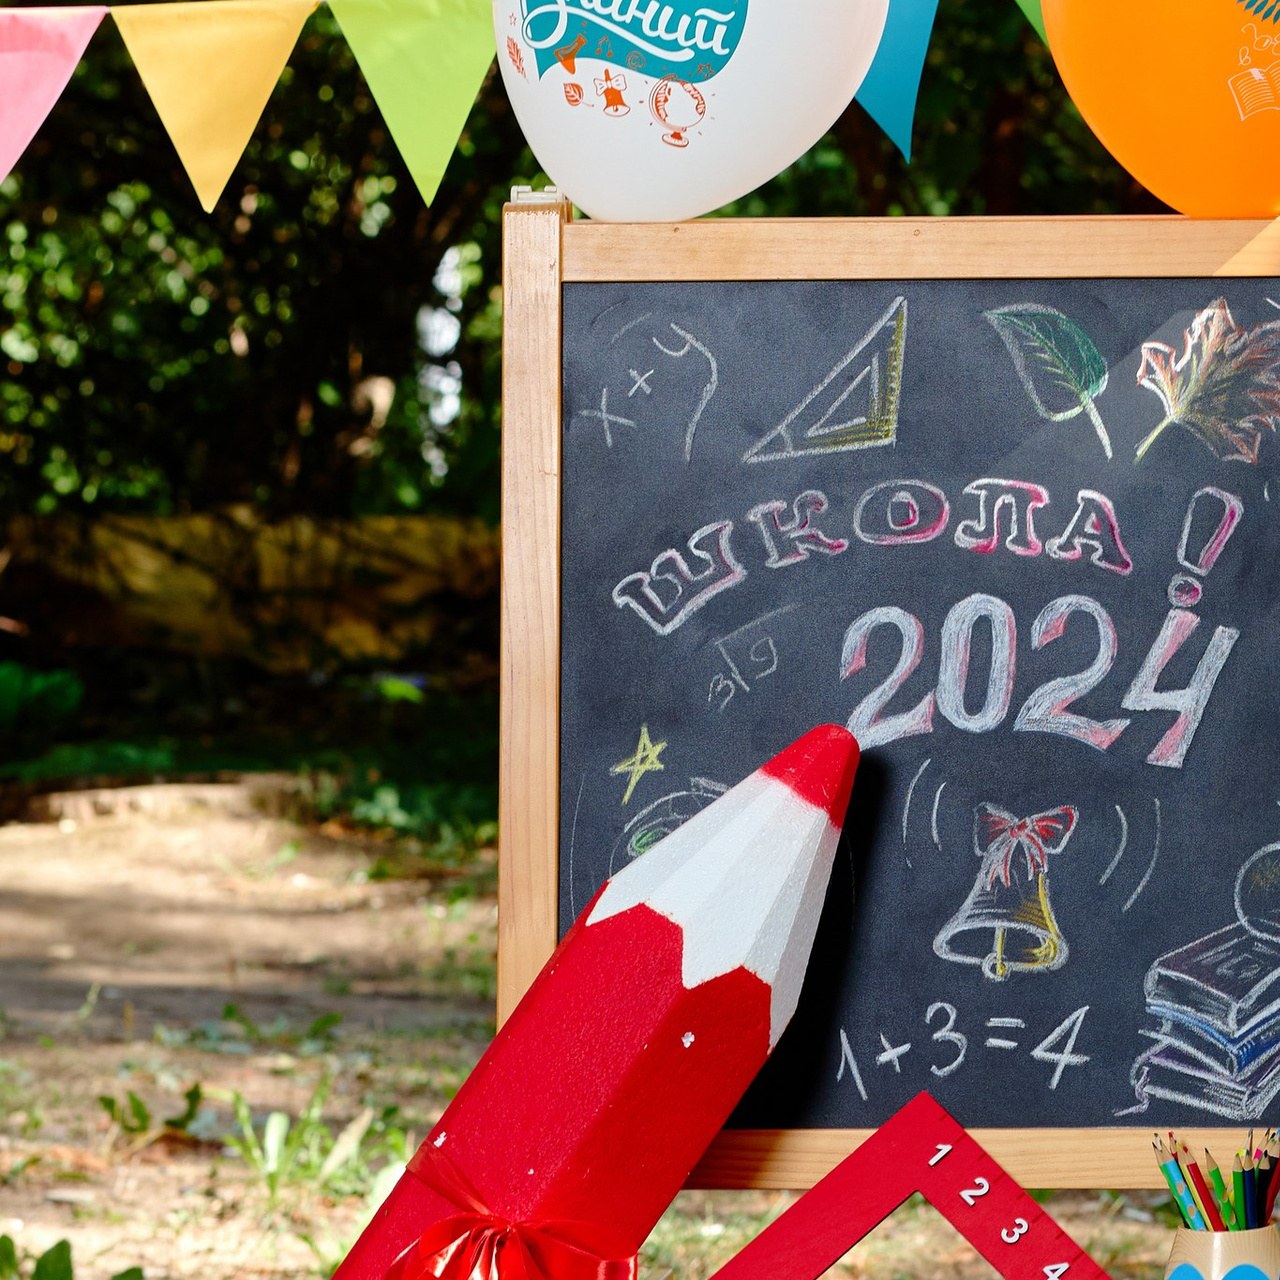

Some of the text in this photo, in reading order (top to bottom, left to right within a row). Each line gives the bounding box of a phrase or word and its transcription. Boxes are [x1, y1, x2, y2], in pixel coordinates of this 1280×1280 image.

[840, 593, 1241, 769] 2024
[928, 1143, 953, 1167] 1
[958, 1177, 990, 1206] 2
[1001, 1218, 1029, 1244] 3
